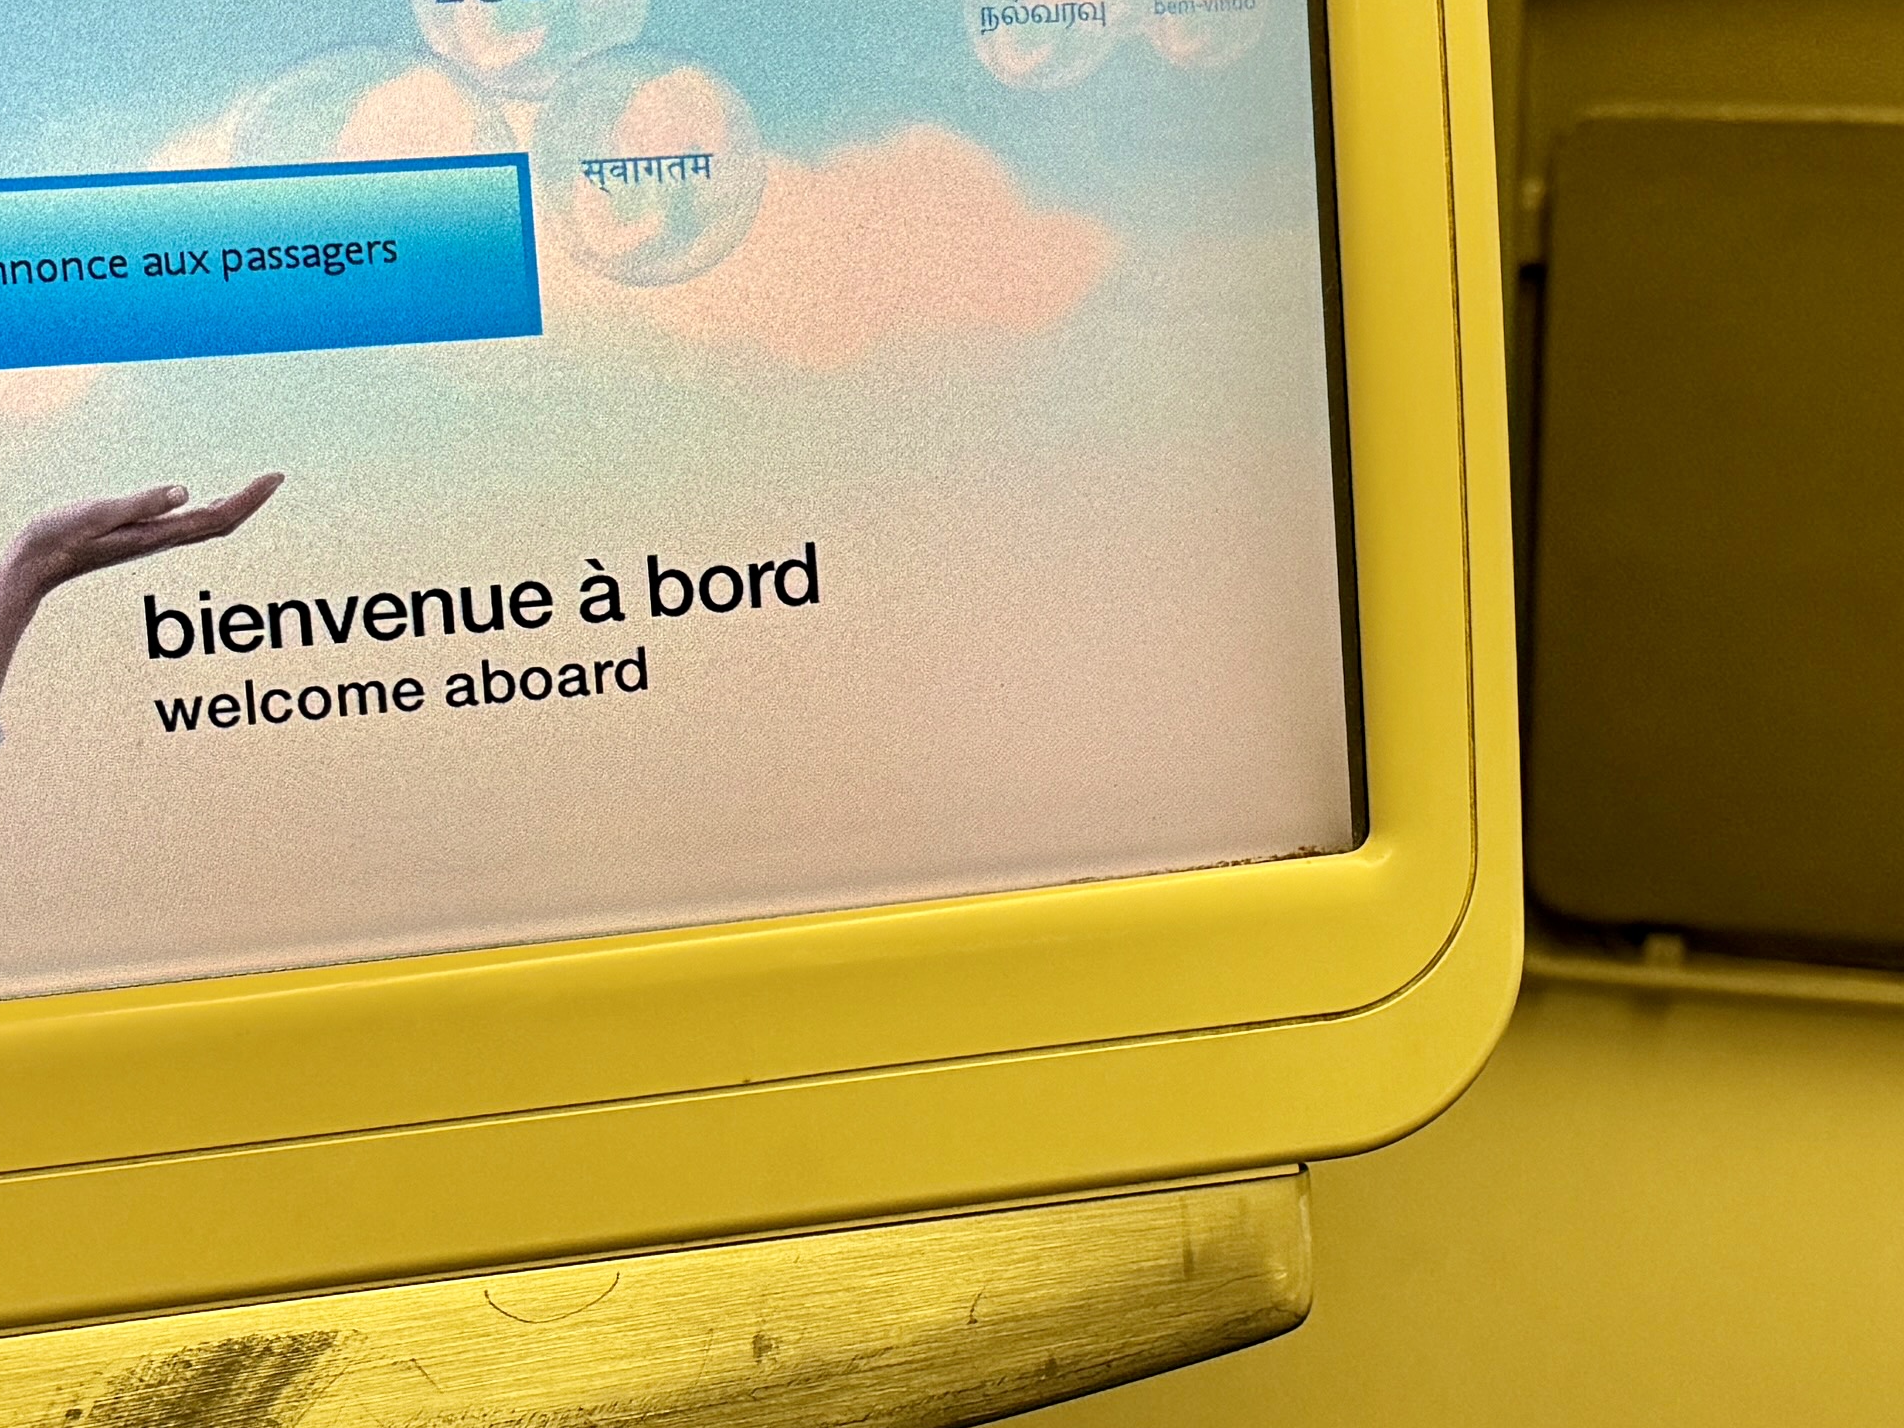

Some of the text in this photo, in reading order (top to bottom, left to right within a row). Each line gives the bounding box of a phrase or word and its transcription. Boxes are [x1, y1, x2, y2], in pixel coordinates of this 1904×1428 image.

[142, 246, 210, 278] aux
[222, 235, 398, 282] passagers
[144, 542, 820, 659] bienvenue à bord
[155, 647, 649, 733] welcome aboard
